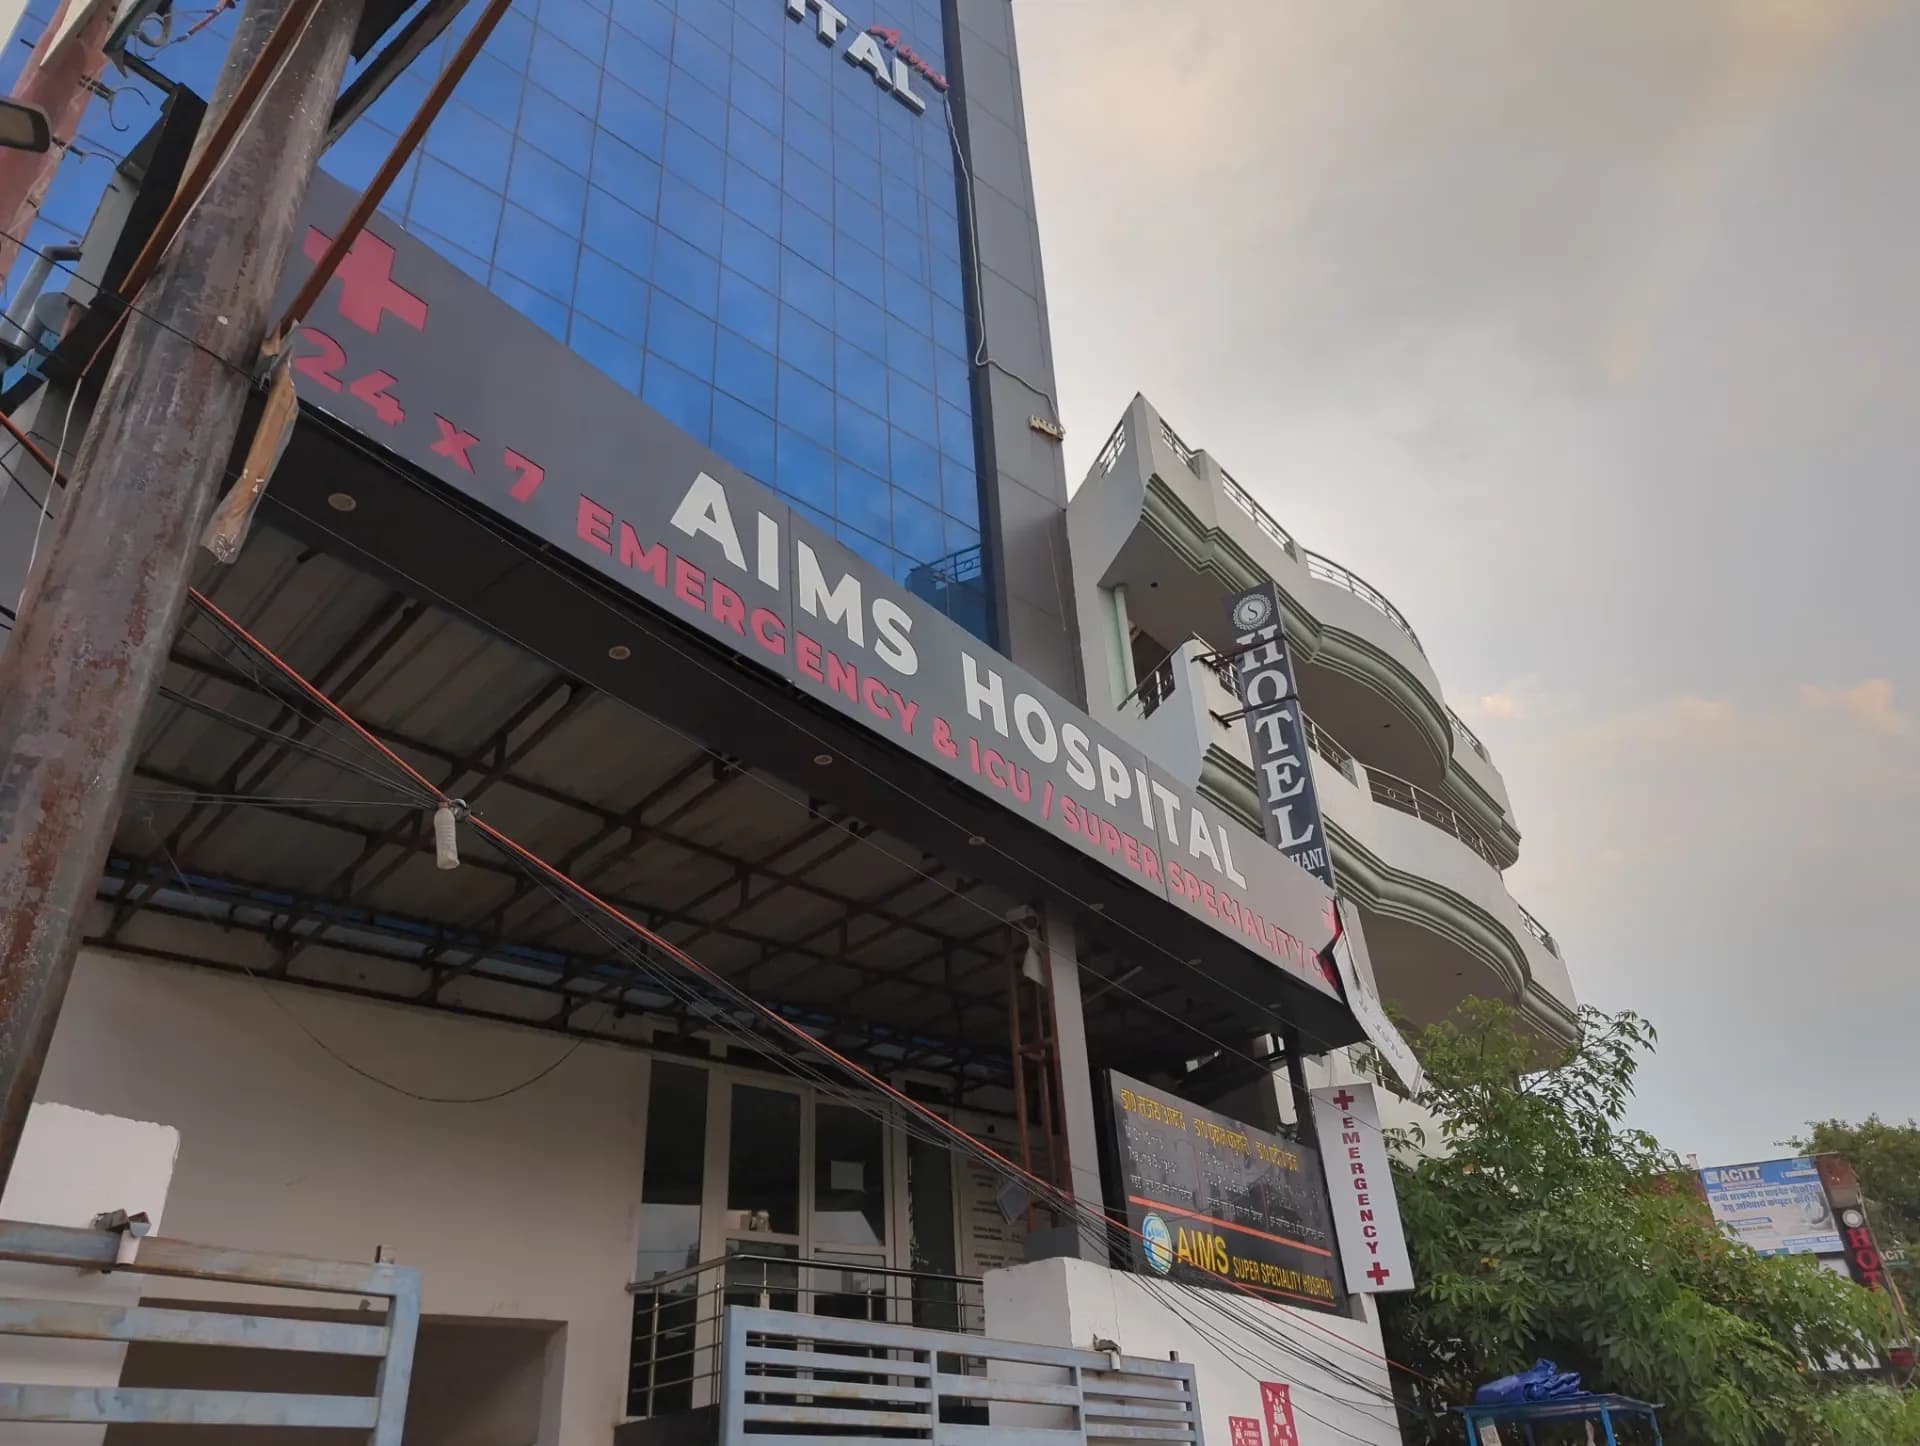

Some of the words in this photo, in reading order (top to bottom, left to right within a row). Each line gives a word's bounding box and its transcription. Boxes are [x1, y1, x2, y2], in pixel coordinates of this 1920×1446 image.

[294, 326, 406, 426] 24
[504, 446, 545, 503] 7
[576, 493, 920, 735] EMERGENCY
[932, 716, 959, 759] &
[968, 735, 1032, 804] ICU
[1059, 792, 1164, 881] SUPER
[1167, 860, 1305, 968] SPECIALITY
[670, 471, 919, 676] AIMS
[960, 651, 1247, 890] HOSPITAL
[1236, 624, 1315, 850] HOTEL
[1177, 1225, 1230, 1275] AIMS
[1232, 1256, 1260, 1280] SUPER
[1260, 1263, 1303, 1291] SPECIALITY
[1302, 1276, 1335, 1299] HOSPITAL
[1342, 1117, 1379, 1255] EMERGENCY
